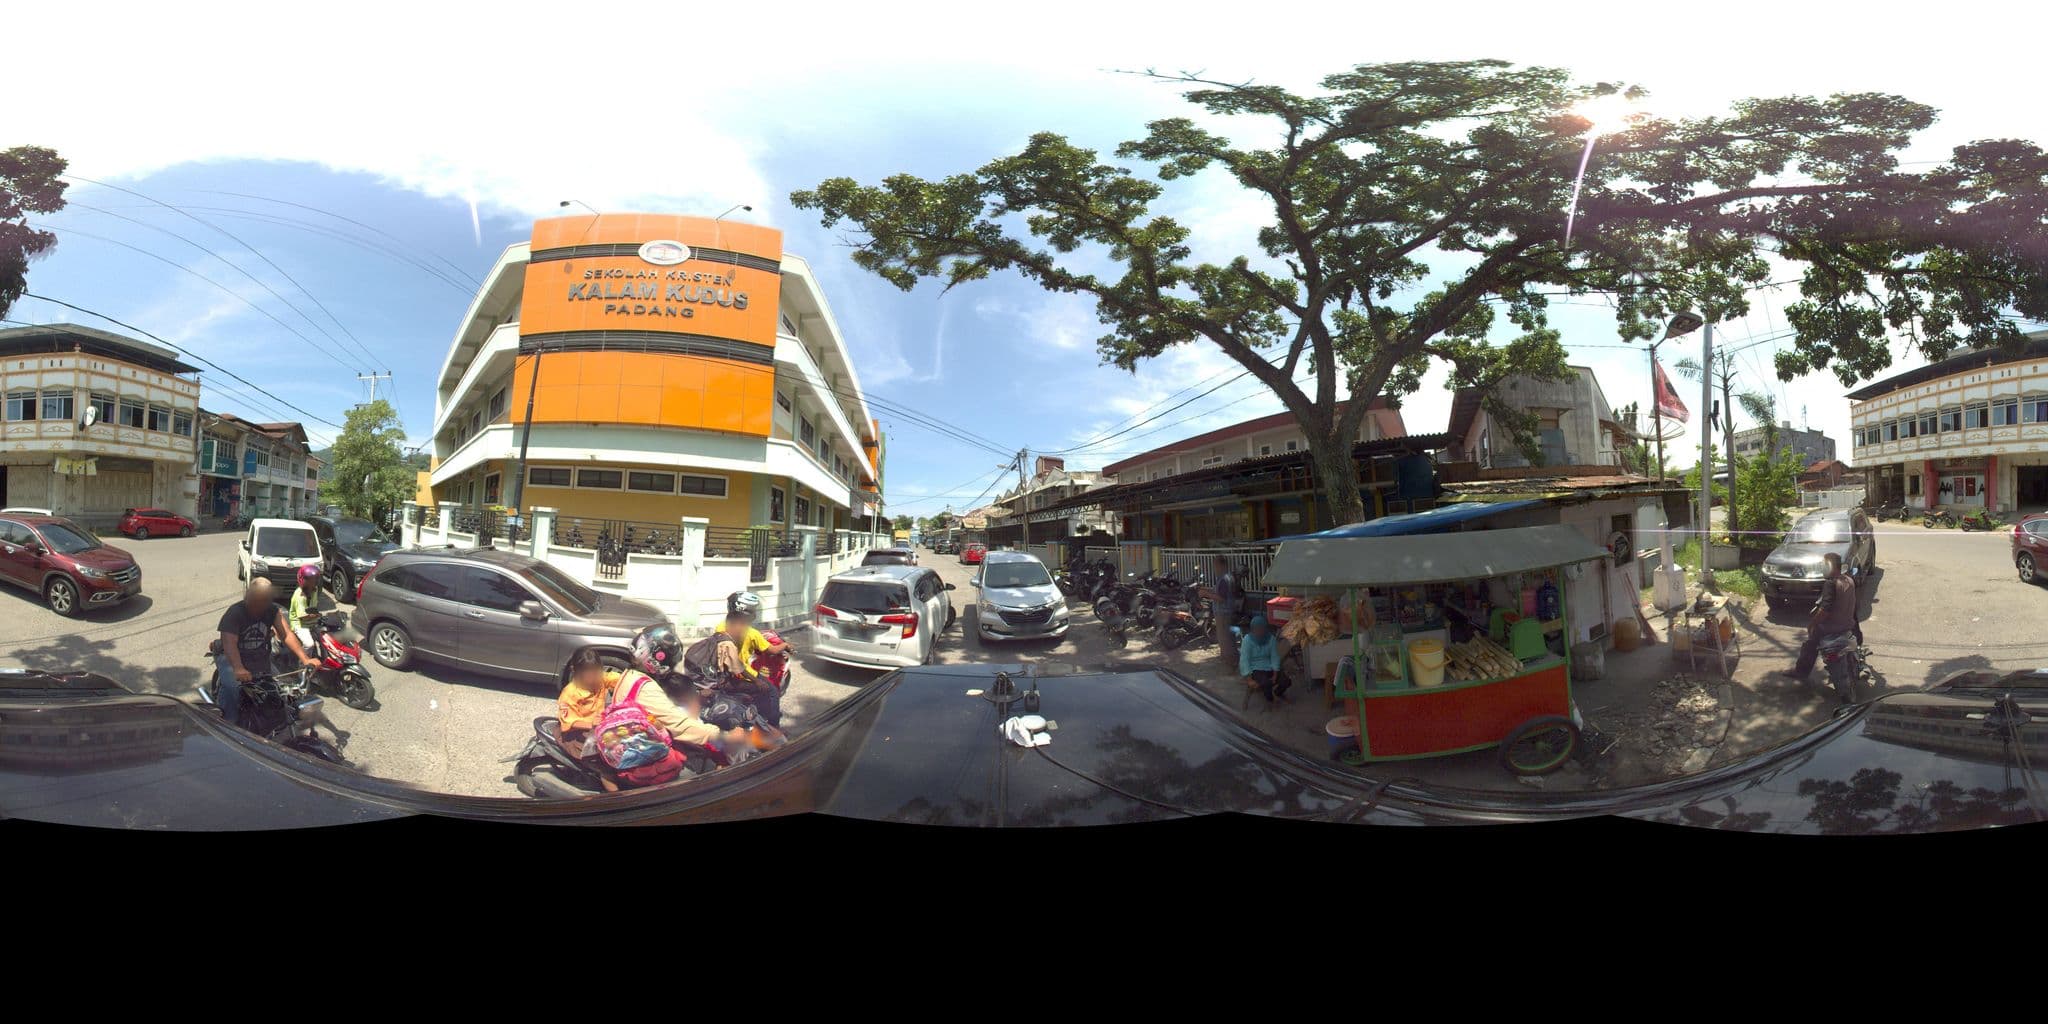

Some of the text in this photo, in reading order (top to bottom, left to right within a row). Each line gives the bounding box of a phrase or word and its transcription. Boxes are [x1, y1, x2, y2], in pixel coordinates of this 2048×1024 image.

[584, 269, 732, 287] SEKOLAH KRISTEN
[568, 282, 748, 309] KALAM KUDUS
[604, 303, 694, 317] PADANG
